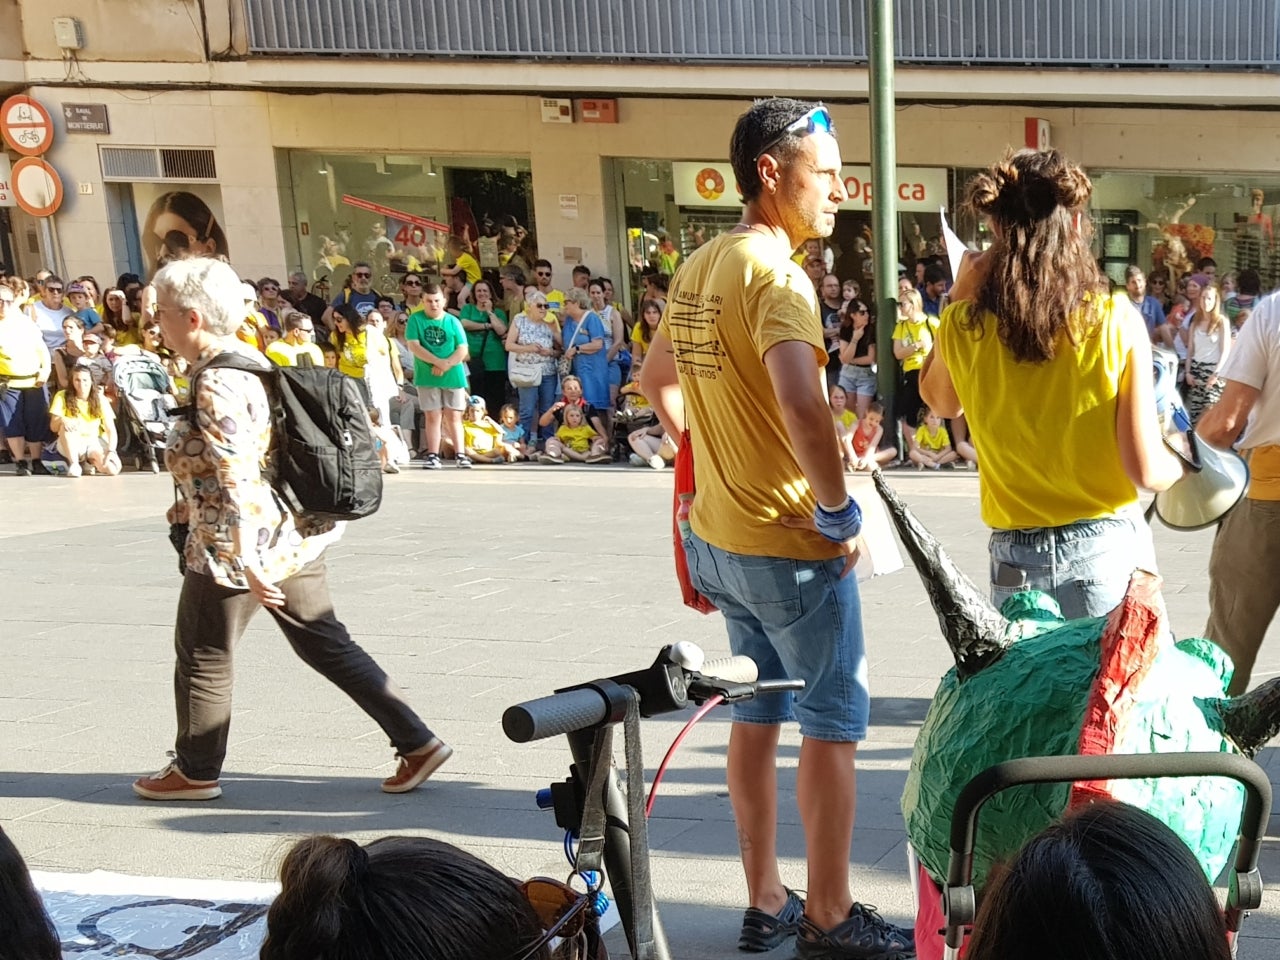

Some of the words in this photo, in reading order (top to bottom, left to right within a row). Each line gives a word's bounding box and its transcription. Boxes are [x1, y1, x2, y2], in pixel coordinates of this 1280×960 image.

[67, 122, 105, 130] MONTSERRAT
[80, 184, 90, 193] 17
[844, 176, 926, 206] Opca
